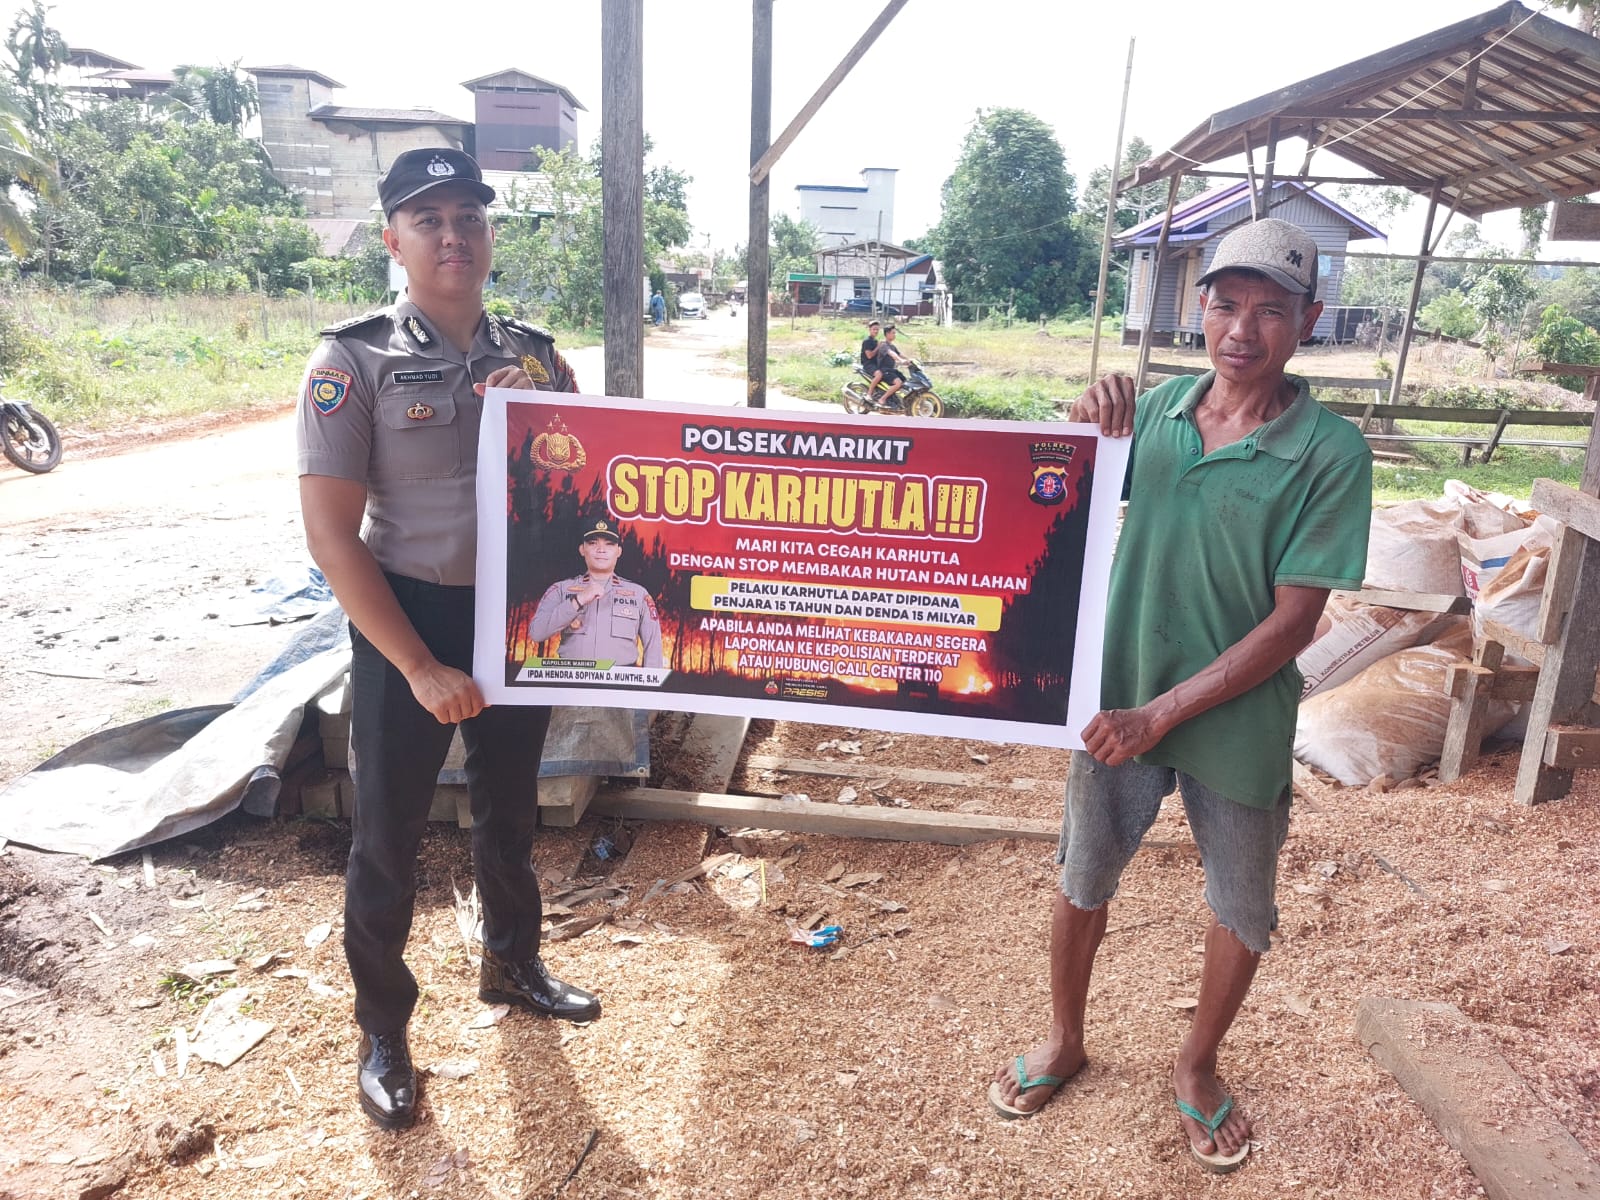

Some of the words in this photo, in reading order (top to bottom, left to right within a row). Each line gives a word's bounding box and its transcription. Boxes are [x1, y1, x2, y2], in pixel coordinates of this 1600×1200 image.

[316, 370, 345, 380] BINMAS
[685, 427, 787, 454] POLSEK
[792, 434, 909, 461] MARIKIT
[614, 462, 715, 517] STOP
[724, 470, 925, 532] KARHUTLA
[935, 483, 979, 535] !!!
[736, 538, 776, 553] MARI
[780, 541, 815, 556] KITA
[818, 543, 872, 560] CEGAH
[876, 547, 960, 566] KARHUTLA
[670, 553, 735, 570] DENGAN
[738, 557, 779, 573] STOP
[782, 560, 872, 580] MEMBAKAR
[876, 567, 930, 584] HUTAN
[933, 571, 968, 587] DAN
[971, 574, 1028, 591] LAHAN
[613, 597, 637, 606] POLRI
[730, 582, 779, 596] PELAKU
[781, 585, 849, 601] KARHUTLA
[851, 590, 894, 604] DAPAT
[896, 593, 960, 609] DIPIDANA
[714, 596, 772, 610] PENJARA
[775, 600, 786, 611] 15
[788, 601, 832, 614] TAHUN
[834, 604, 862, 616] DAN
[865, 606, 909, 619] DENDA
[912, 610, 924, 621] 15
[926, 611, 975, 625] MILYAR
[700, 617, 753, 634] APABILA
[756, 621, 793, 637] ANDA
[795, 624, 851, 641] MELIHAT
[853, 628, 933, 647] KEBAKARAN
[935, 635, 987, 652] SEGERA
[725, 636, 794, 653] LAPORKAN
[797, 641, 813, 655] KE
[815, 642, 891, 661] KEPOLISIAN
[894, 649, 961, 667] TERDEKAT
[527, 669, 543, 679] IPDA
[544, 670, 574, 680] HENDRA
[575, 671, 605, 681] SOPIYAN
[605, 672, 613, 681] D.
[614, 673, 645, 684] MUNTHE,
[646, 674, 660, 684] S.H.
[739, 654, 772, 669] ATAU
[775, 656, 834, 674] HUBUNGI
[836, 661, 869, 677] CALL
[870, 664, 921, 681] CENTER
[923, 668, 943, 683] 110
